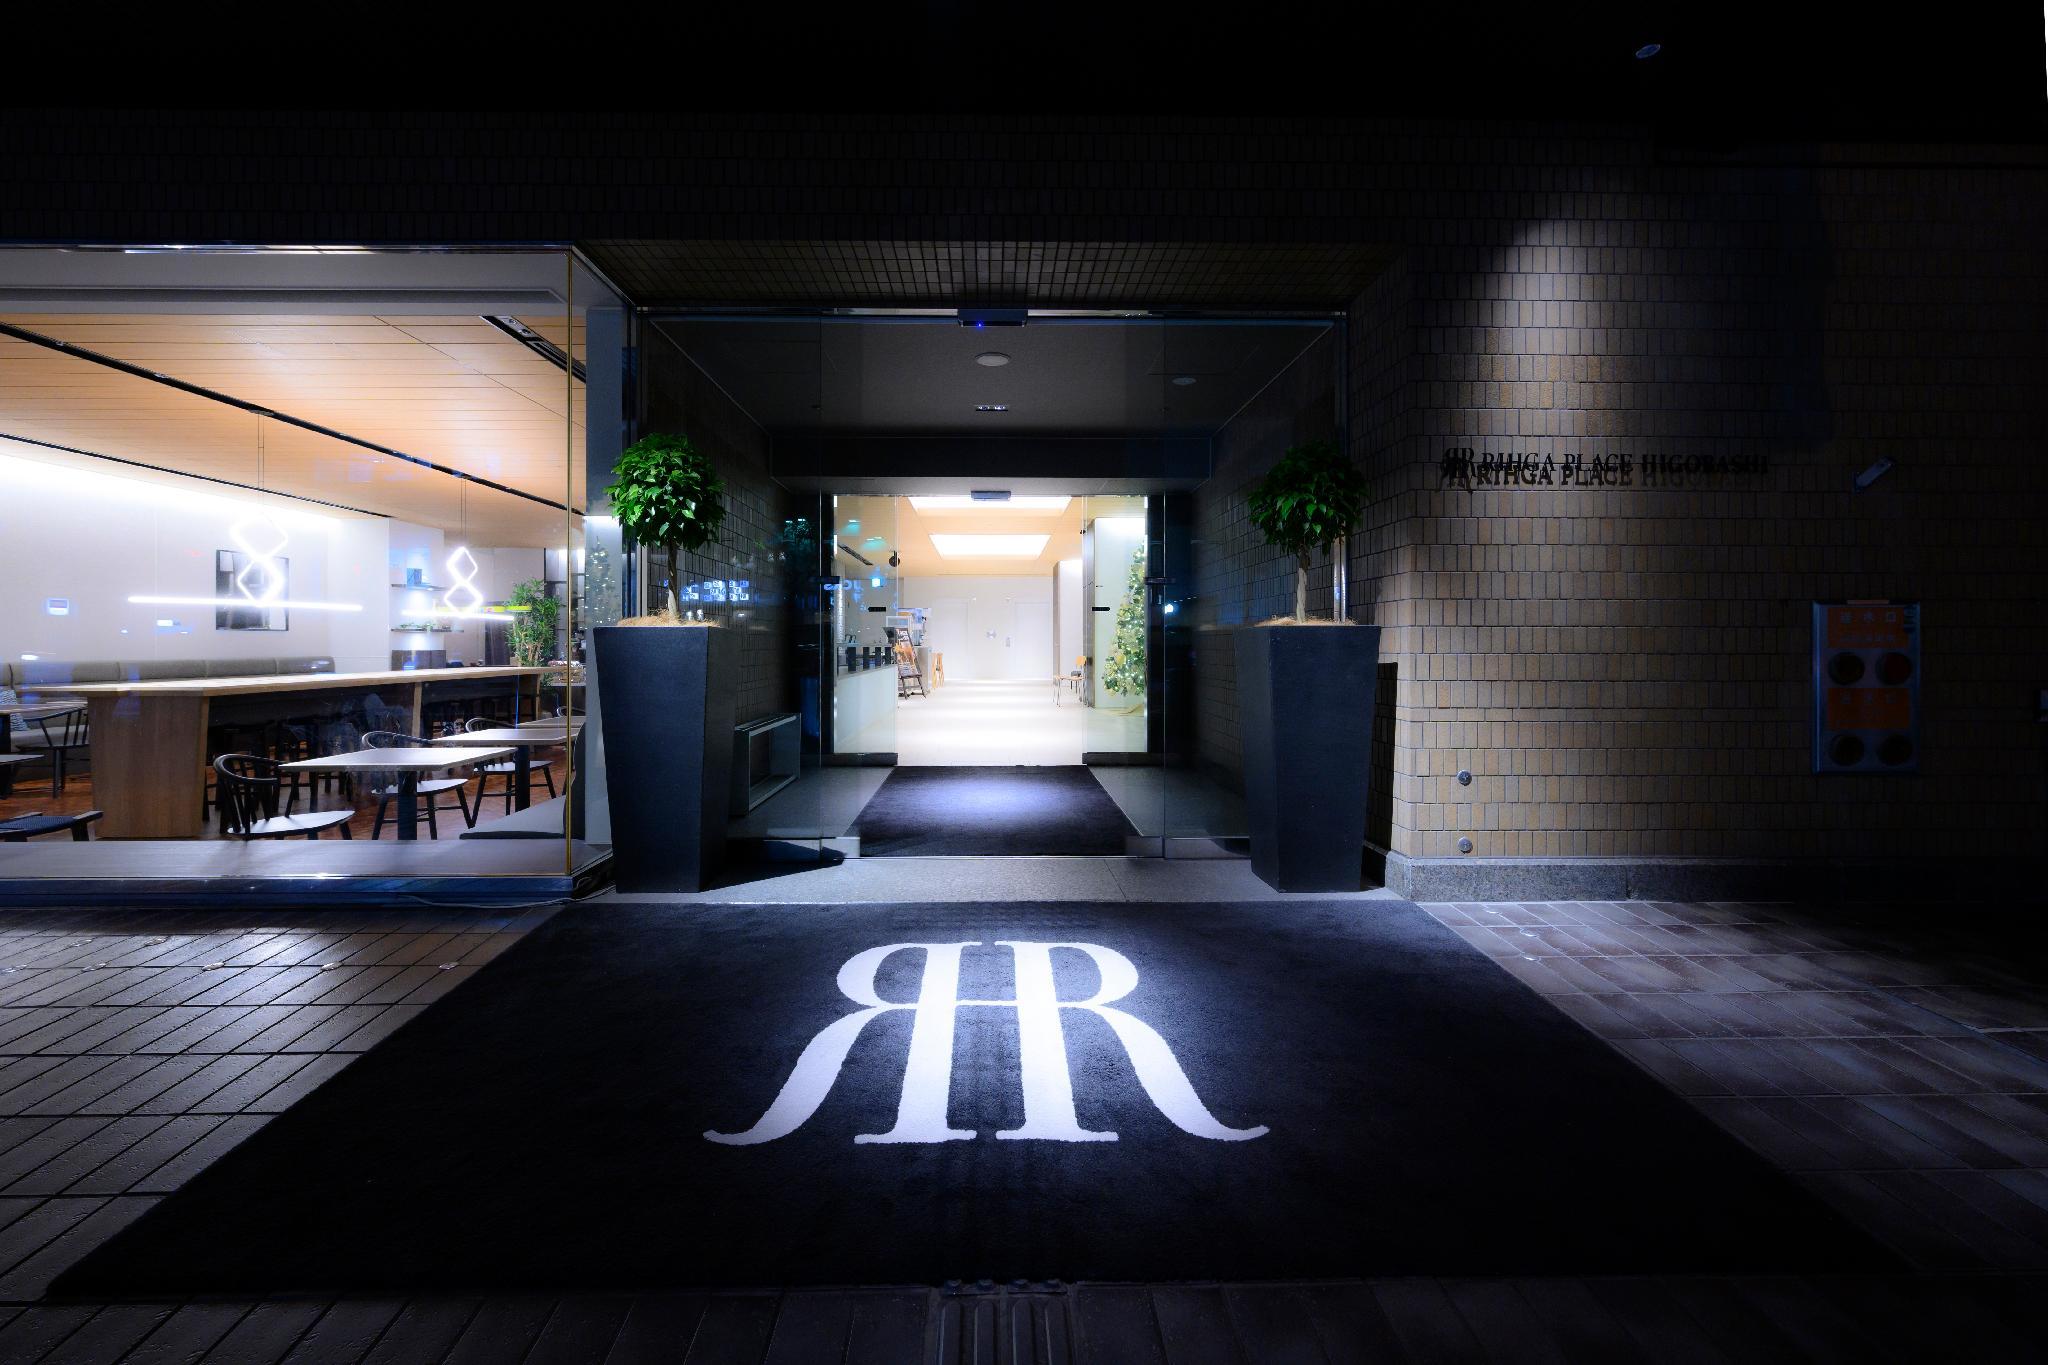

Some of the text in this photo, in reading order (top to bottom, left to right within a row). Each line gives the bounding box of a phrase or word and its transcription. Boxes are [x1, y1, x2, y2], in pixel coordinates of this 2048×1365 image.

[1481, 453, 1769, 474] RIHGA PLACE HIGOBASHI
